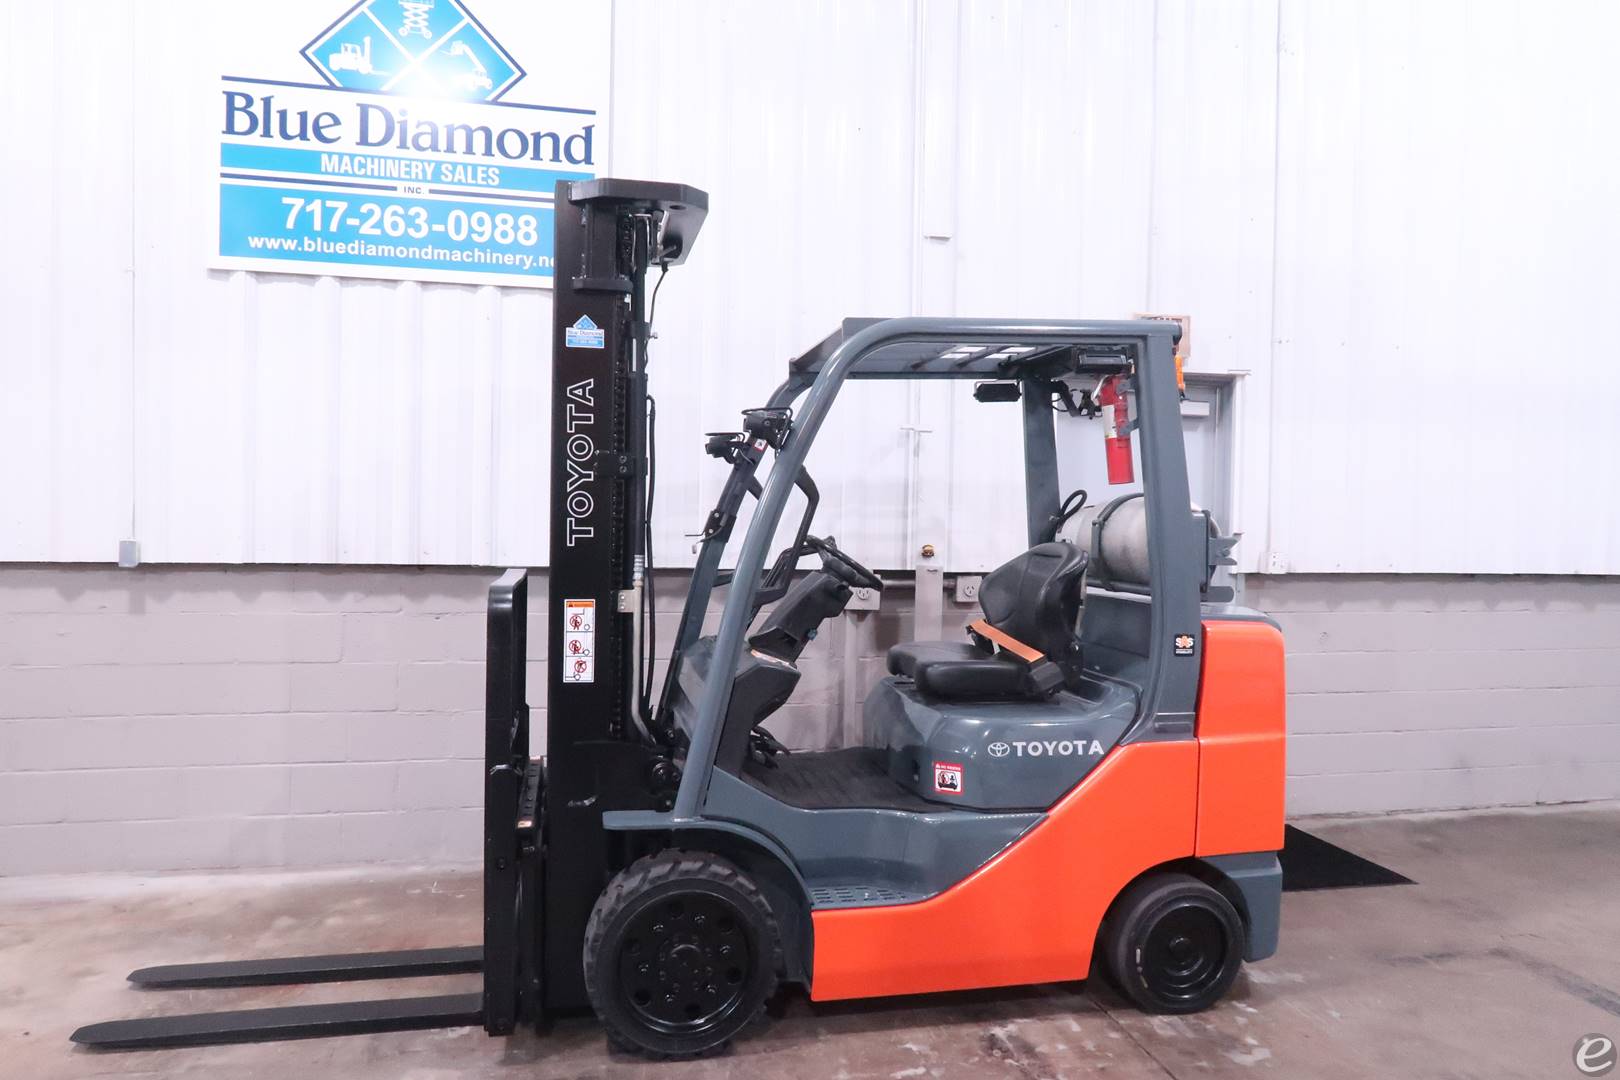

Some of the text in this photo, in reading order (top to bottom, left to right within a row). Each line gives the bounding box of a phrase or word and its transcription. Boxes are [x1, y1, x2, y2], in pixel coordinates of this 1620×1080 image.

[222, 90, 595, 165] Blue Diamond
[320, 153, 500, 186] MACHINERY SALES
[404, 186, 425, 195] INC.
[281, 196, 538, 247] 717-263-0988
[567, 378, 594, 547] TOYOTA
[1012, 740, 1105, 757] TOYOTA
